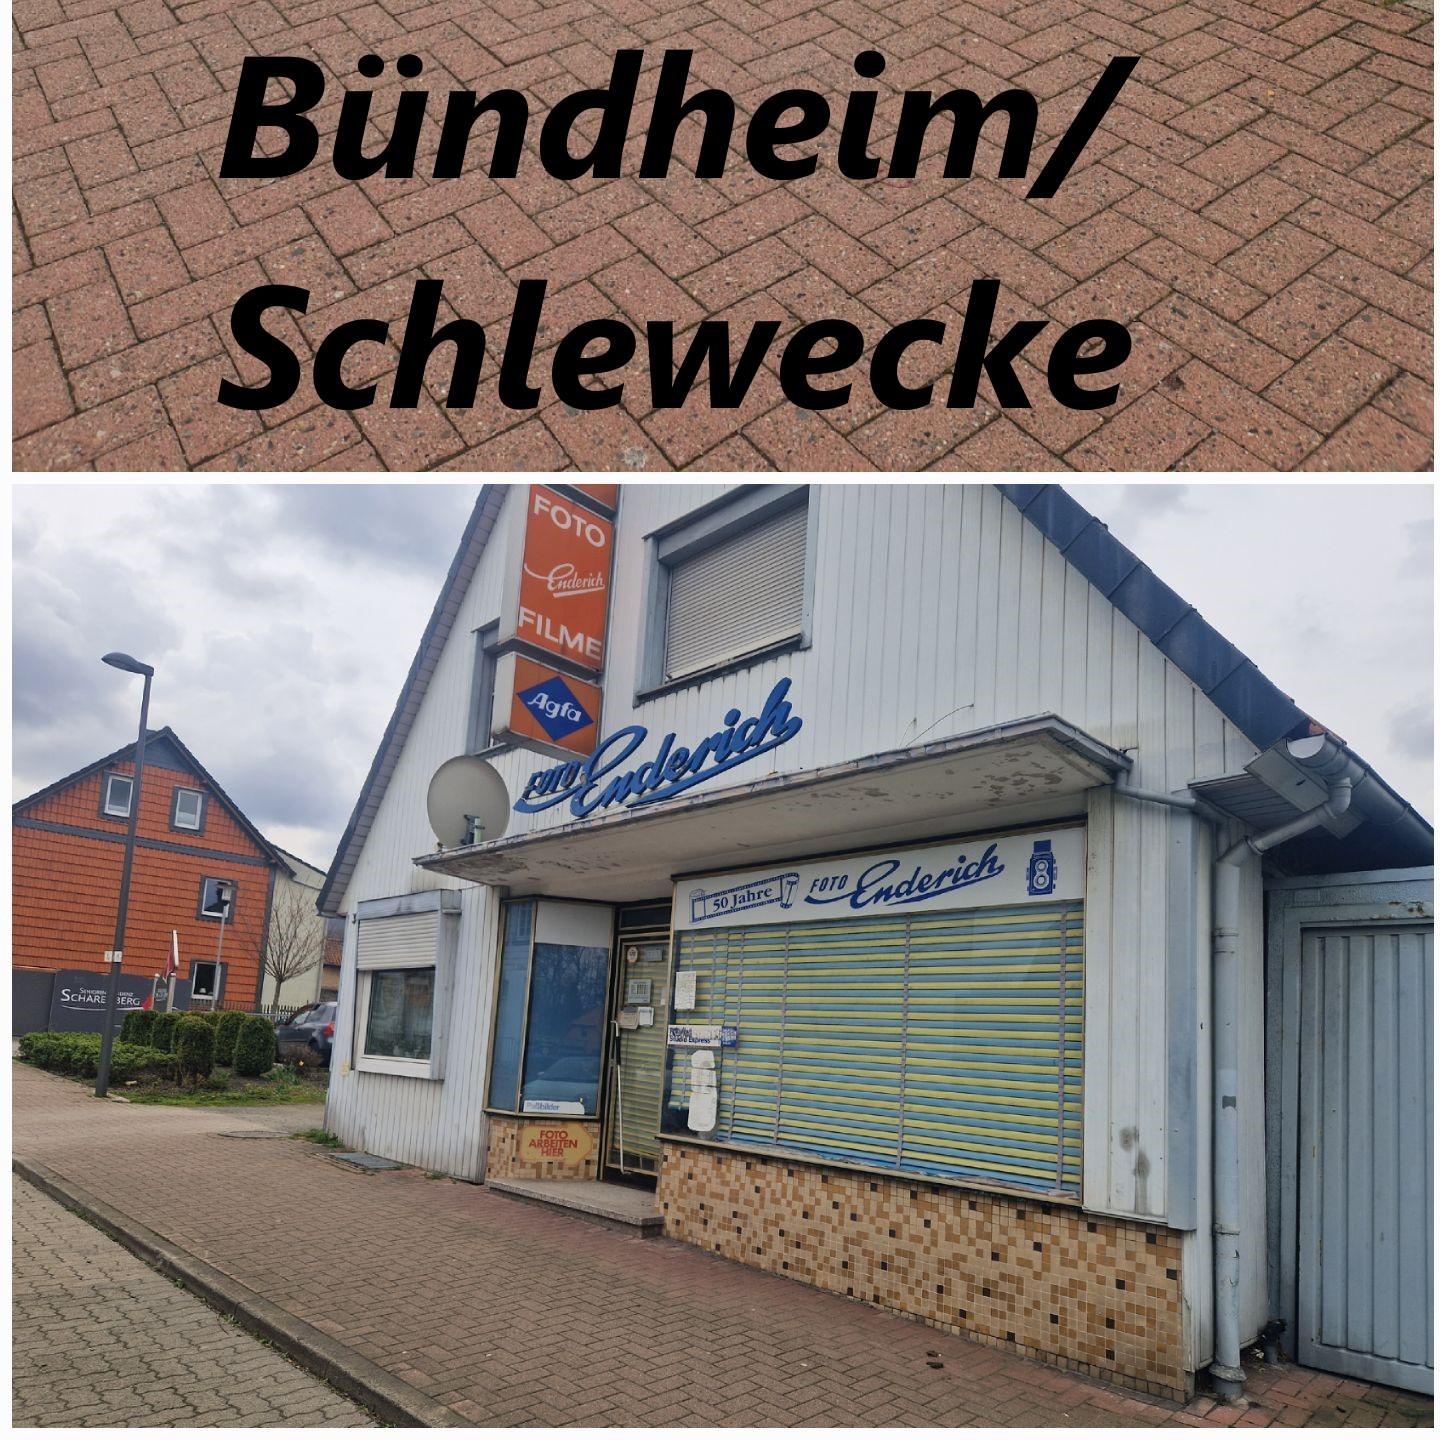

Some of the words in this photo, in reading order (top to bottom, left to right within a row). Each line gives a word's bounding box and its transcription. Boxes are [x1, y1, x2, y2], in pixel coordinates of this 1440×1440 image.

[534, 494, 606, 548] FOTO
[524, 563, 605, 598] Enderich
[518, 607, 602, 657] FILME
[527, 691, 582, 723] Agfa
[525, 760, 584, 799] FOTO
[560, 677, 803, 817] Enderich
[713, 896, 729, 912] 50
[731, 885, 773, 909] Jahre
[809, 873, 848, 894] FOTO
[846, 842, 1005, 909] Enderich
[529, 1139, 577, 1148] ARBEITEN
[540, 1130, 568, 1139] FOTO
[541, 1148, 564, 1157] HIER
